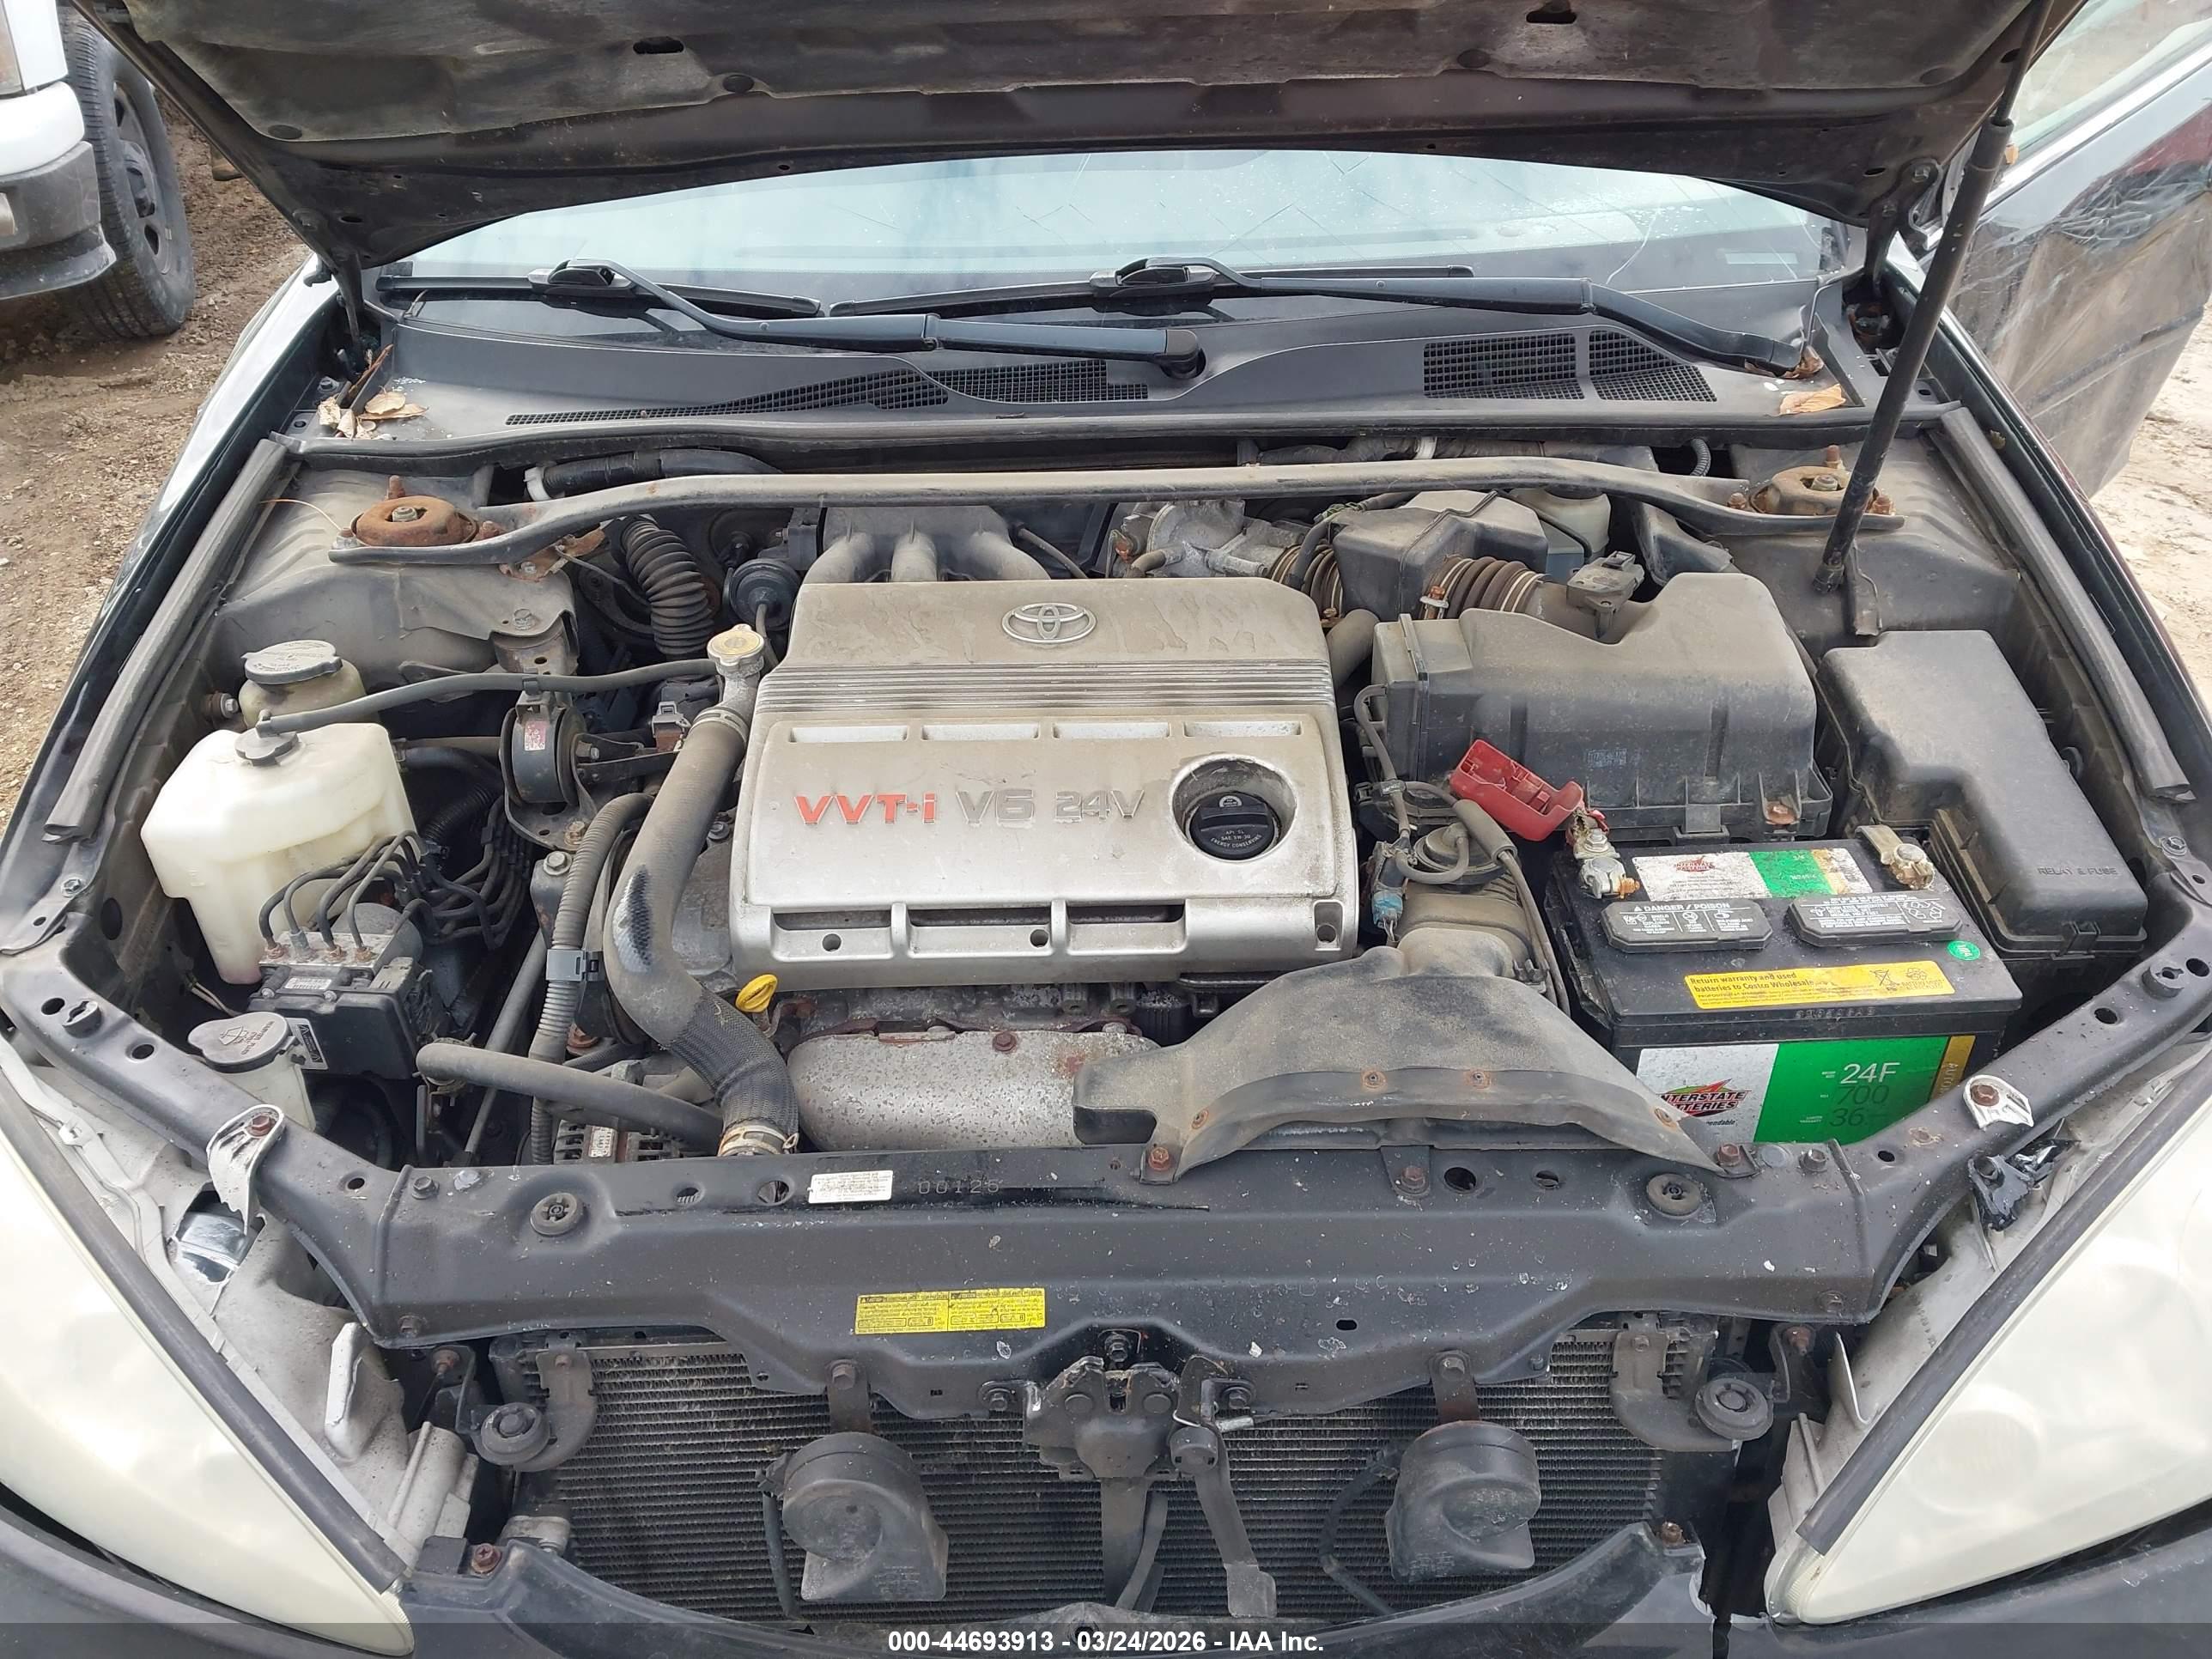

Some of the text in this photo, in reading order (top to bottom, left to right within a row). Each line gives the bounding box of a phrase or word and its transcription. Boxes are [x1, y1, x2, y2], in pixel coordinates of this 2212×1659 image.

[956, 789, 1034, 828] V6
[1055, 790, 1145, 823] 24V
[1211, 834, 1262, 848] ENERGY CONSERVING
[1690, 975, 1719, 984] Return
[1720, 974, 1758, 984] warranty
[1694, 984, 1732, 993] batteries
[1771, 979, 1814, 988] Wholesale
[1840, 1062, 1901, 1085] 24F
[1660, 1091, 1746, 1102] NTERSTATE
[1837, 1085, 1890, 1105] 700
